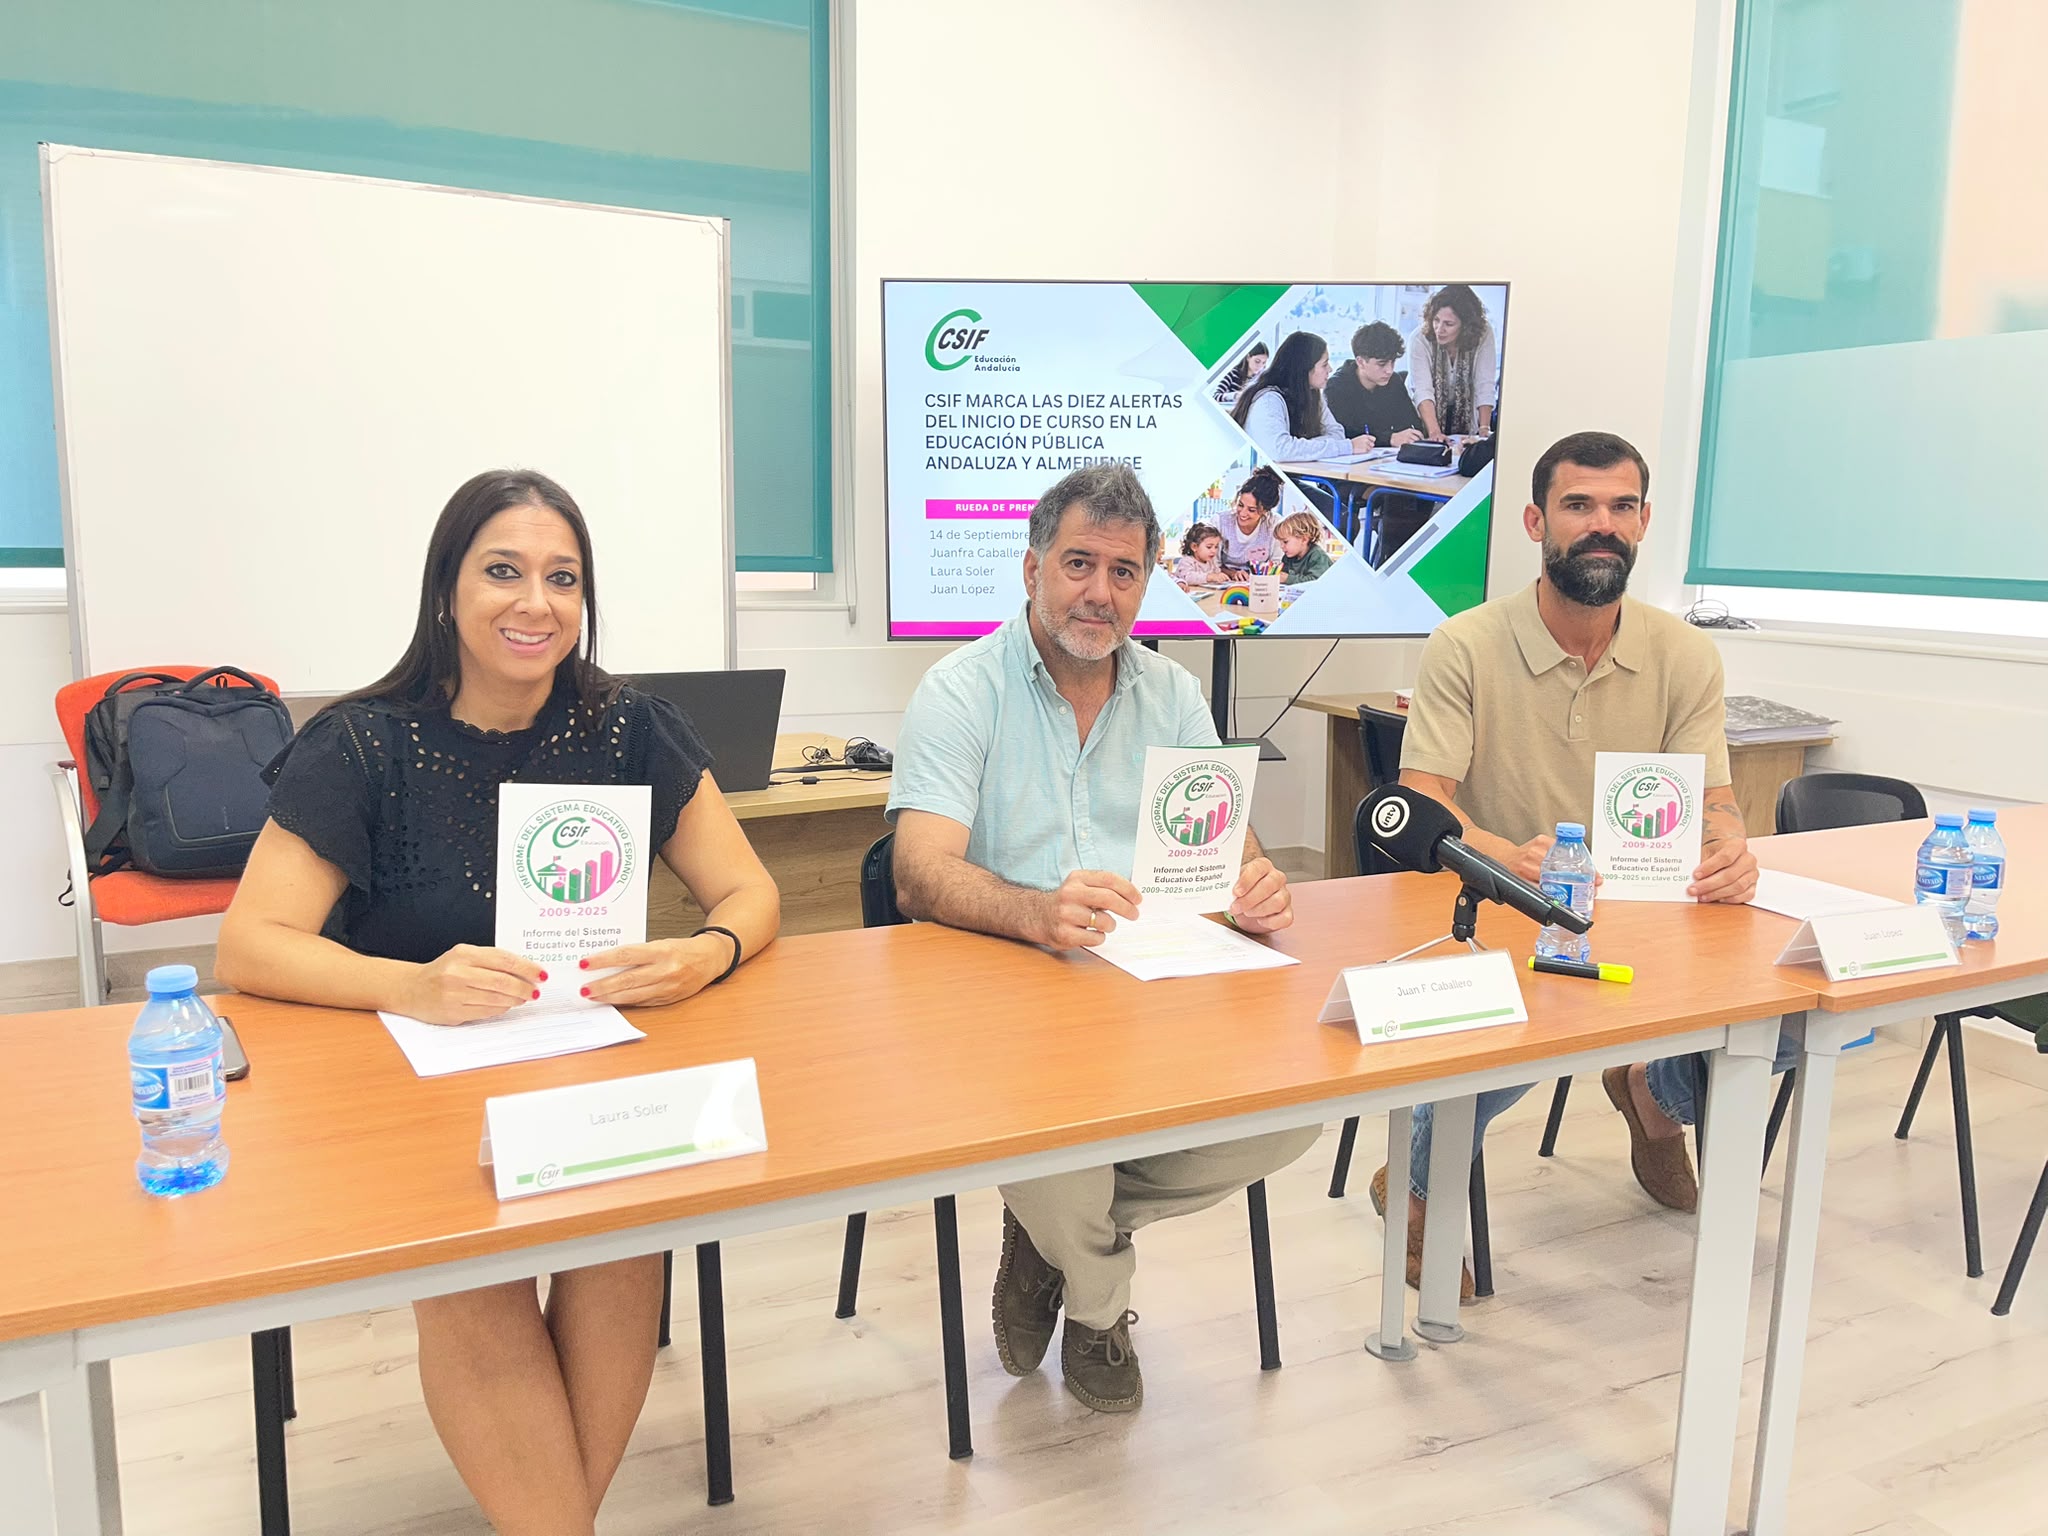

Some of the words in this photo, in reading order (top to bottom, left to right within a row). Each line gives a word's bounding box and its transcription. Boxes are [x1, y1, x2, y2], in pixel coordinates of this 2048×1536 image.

[938, 328, 990, 350] CSIF
[974, 355, 1017, 363] Educación
[974, 364, 1021, 372] Andalucía
[925, 394, 962, 408] CSIF
[966, 394, 1028, 408] MARCA
[1032, 394, 1063, 408] LAS
[1067, 394, 1105, 408] DIEZ
[1109, 394, 1183, 409] ALERTAS
[925, 415, 957, 429] DEL
[961, 415, 1016, 429] INICIO
[1020, 415, 1042, 429] DE
[1046, 415, 1105, 429] CURSO
[1110, 415, 1131, 429] EN
[1136, 415, 1158, 429] LA
[926, 432, 1027, 449] EDUCACIÓN
[1031, 432, 1105, 450] PÚBLICA
[925, 456, 1018, 470] ANDALUZA
[1022, 456, 1032, 470] Y
[955, 504, 989, 512] RUEDA
[992, 504, 1005, 512] DE
[1009, 504, 1035, 512] PREN
[930, 530, 943, 540] 14
[946, 530, 961, 540] de
[930, 548, 975, 558] Juanfra
[977, 548, 1025, 558] Caballer
[930, 566, 962, 576] Laura
[965, 566, 995, 576] Soler
[930, 584, 958, 594] Juan
[961, 584, 995, 596] López
[1620, 766, 1653, 782] SISTEMA
[1655, 766, 1688, 793] EDUCATIVO
[1190, 781, 1215, 792] CSIF
[1610, 781, 1623, 793] DEL
[1638, 782, 1660, 791] CSIF
[1154, 797, 1166, 835] INFORME
[1161, 781, 1175, 795] DEL
[1173, 763, 1209, 781] SISTEMA
[1210, 763, 1241, 792] EDUCATIVO
[535, 803, 581, 825] SISTEMA
[1382, 806, 1396, 826] intv
[1606, 795, 1618, 828] INFORME
[583, 803, 629, 840] EDUCATIVO
[522, 822, 537, 841] DEL
[560, 825, 591, 838] CSIF
[1622, 841, 1673, 849] 2009-2025
[1167, 848, 1219, 858] 2009-2025
[516, 843, 532, 889] INFORME
[1185, 865, 1197, 873] del
[1199, 863, 1226, 872] Sistema
[1154, 875, 1193, 883] Educativo
[1195, 873, 1223, 883] Español
[1652, 874, 1671, 882] clave
[1195, 884, 1213, 892] clave
[1214, 881, 1231, 890] CSIF
[539, 906, 608, 917] 2009-2025
[522, 929, 562, 938] Informe
[564, 928, 580, 937] del
[582, 927, 622, 937] Sistema
[525, 940, 576, 950] Educativo
[578, 938, 619, 949] Español
[1397, 986, 1420, 997] Juan
[1430, 979, 1473, 992] Caballero
[589, 1110, 630, 1126] Laura
[633, 1103, 670, 1118] Soler
[541, 1168, 561, 1180] CSIF
